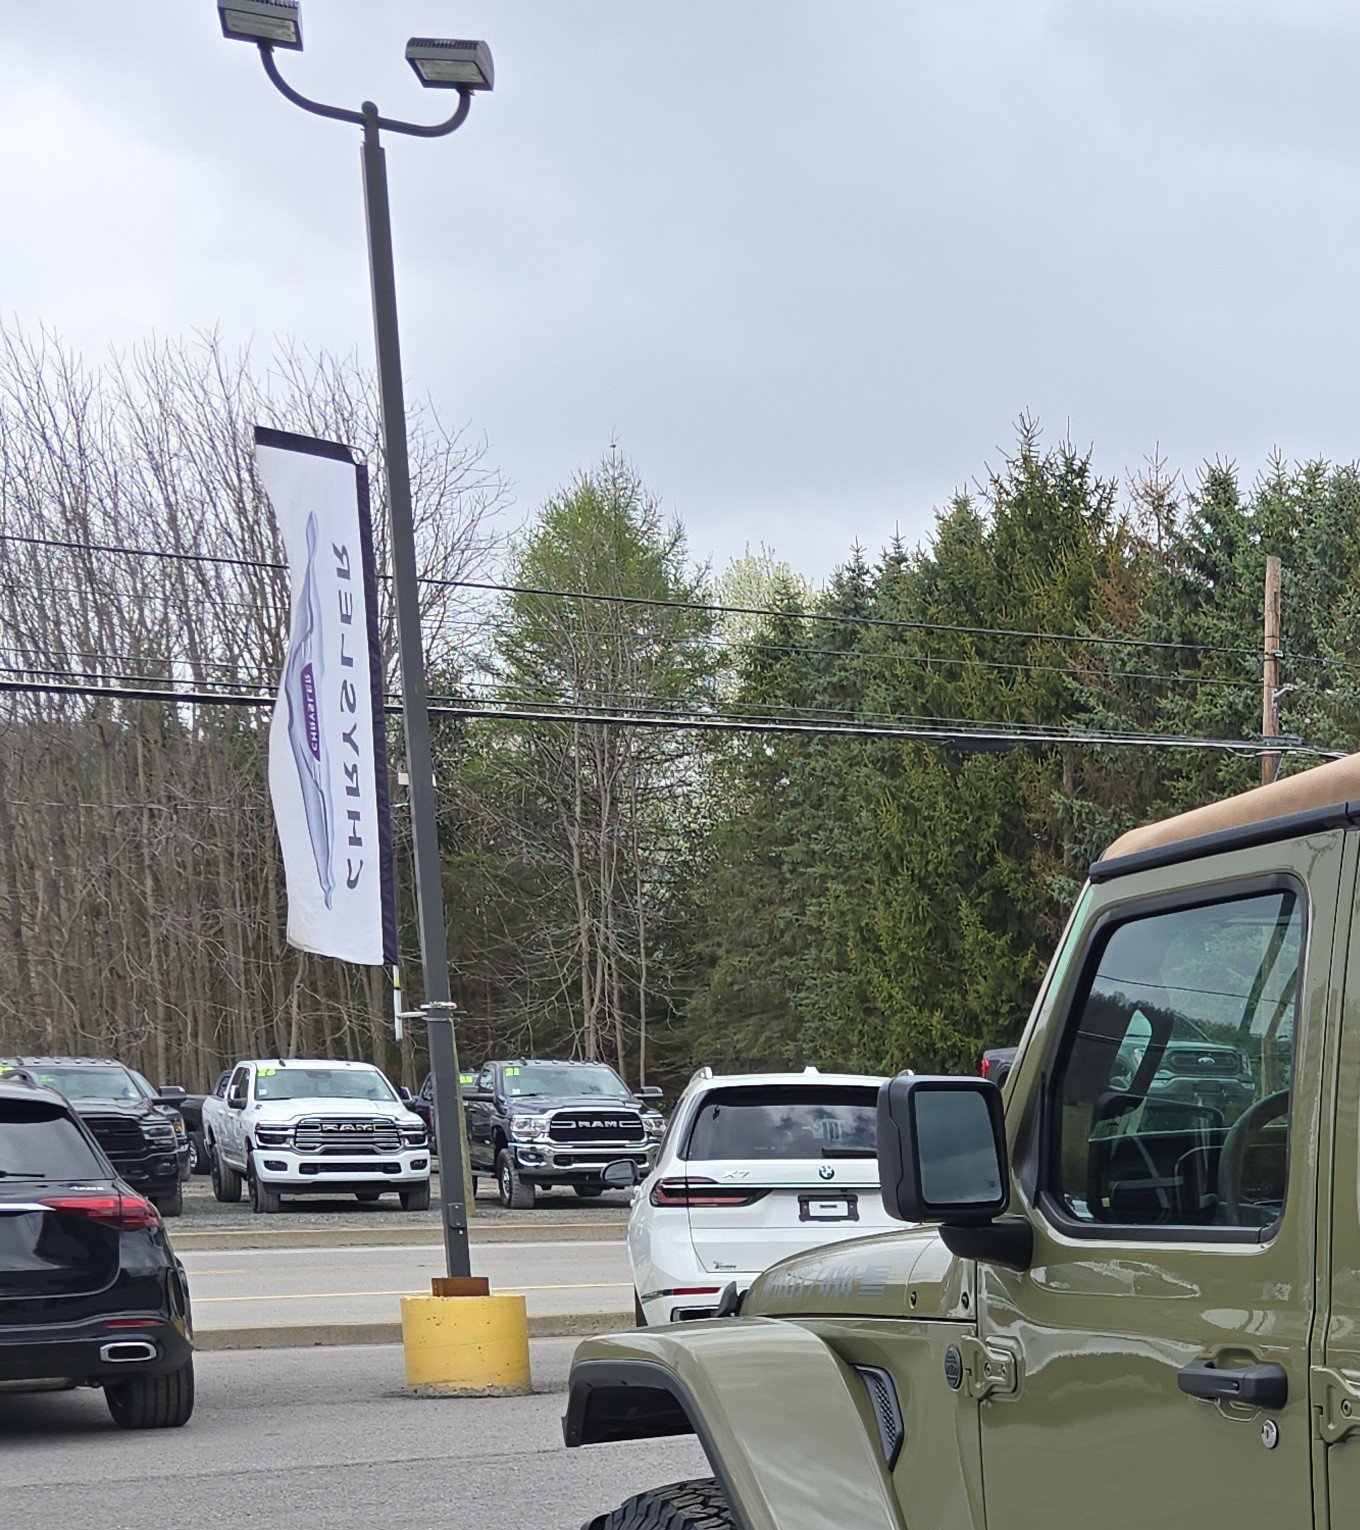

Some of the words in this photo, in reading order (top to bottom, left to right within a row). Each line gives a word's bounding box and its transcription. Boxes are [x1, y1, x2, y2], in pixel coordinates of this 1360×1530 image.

[321, 1123, 374, 1131] RAM
[578, 1120, 618, 1128] RAM
[723, 1169, 750, 1179] X7
